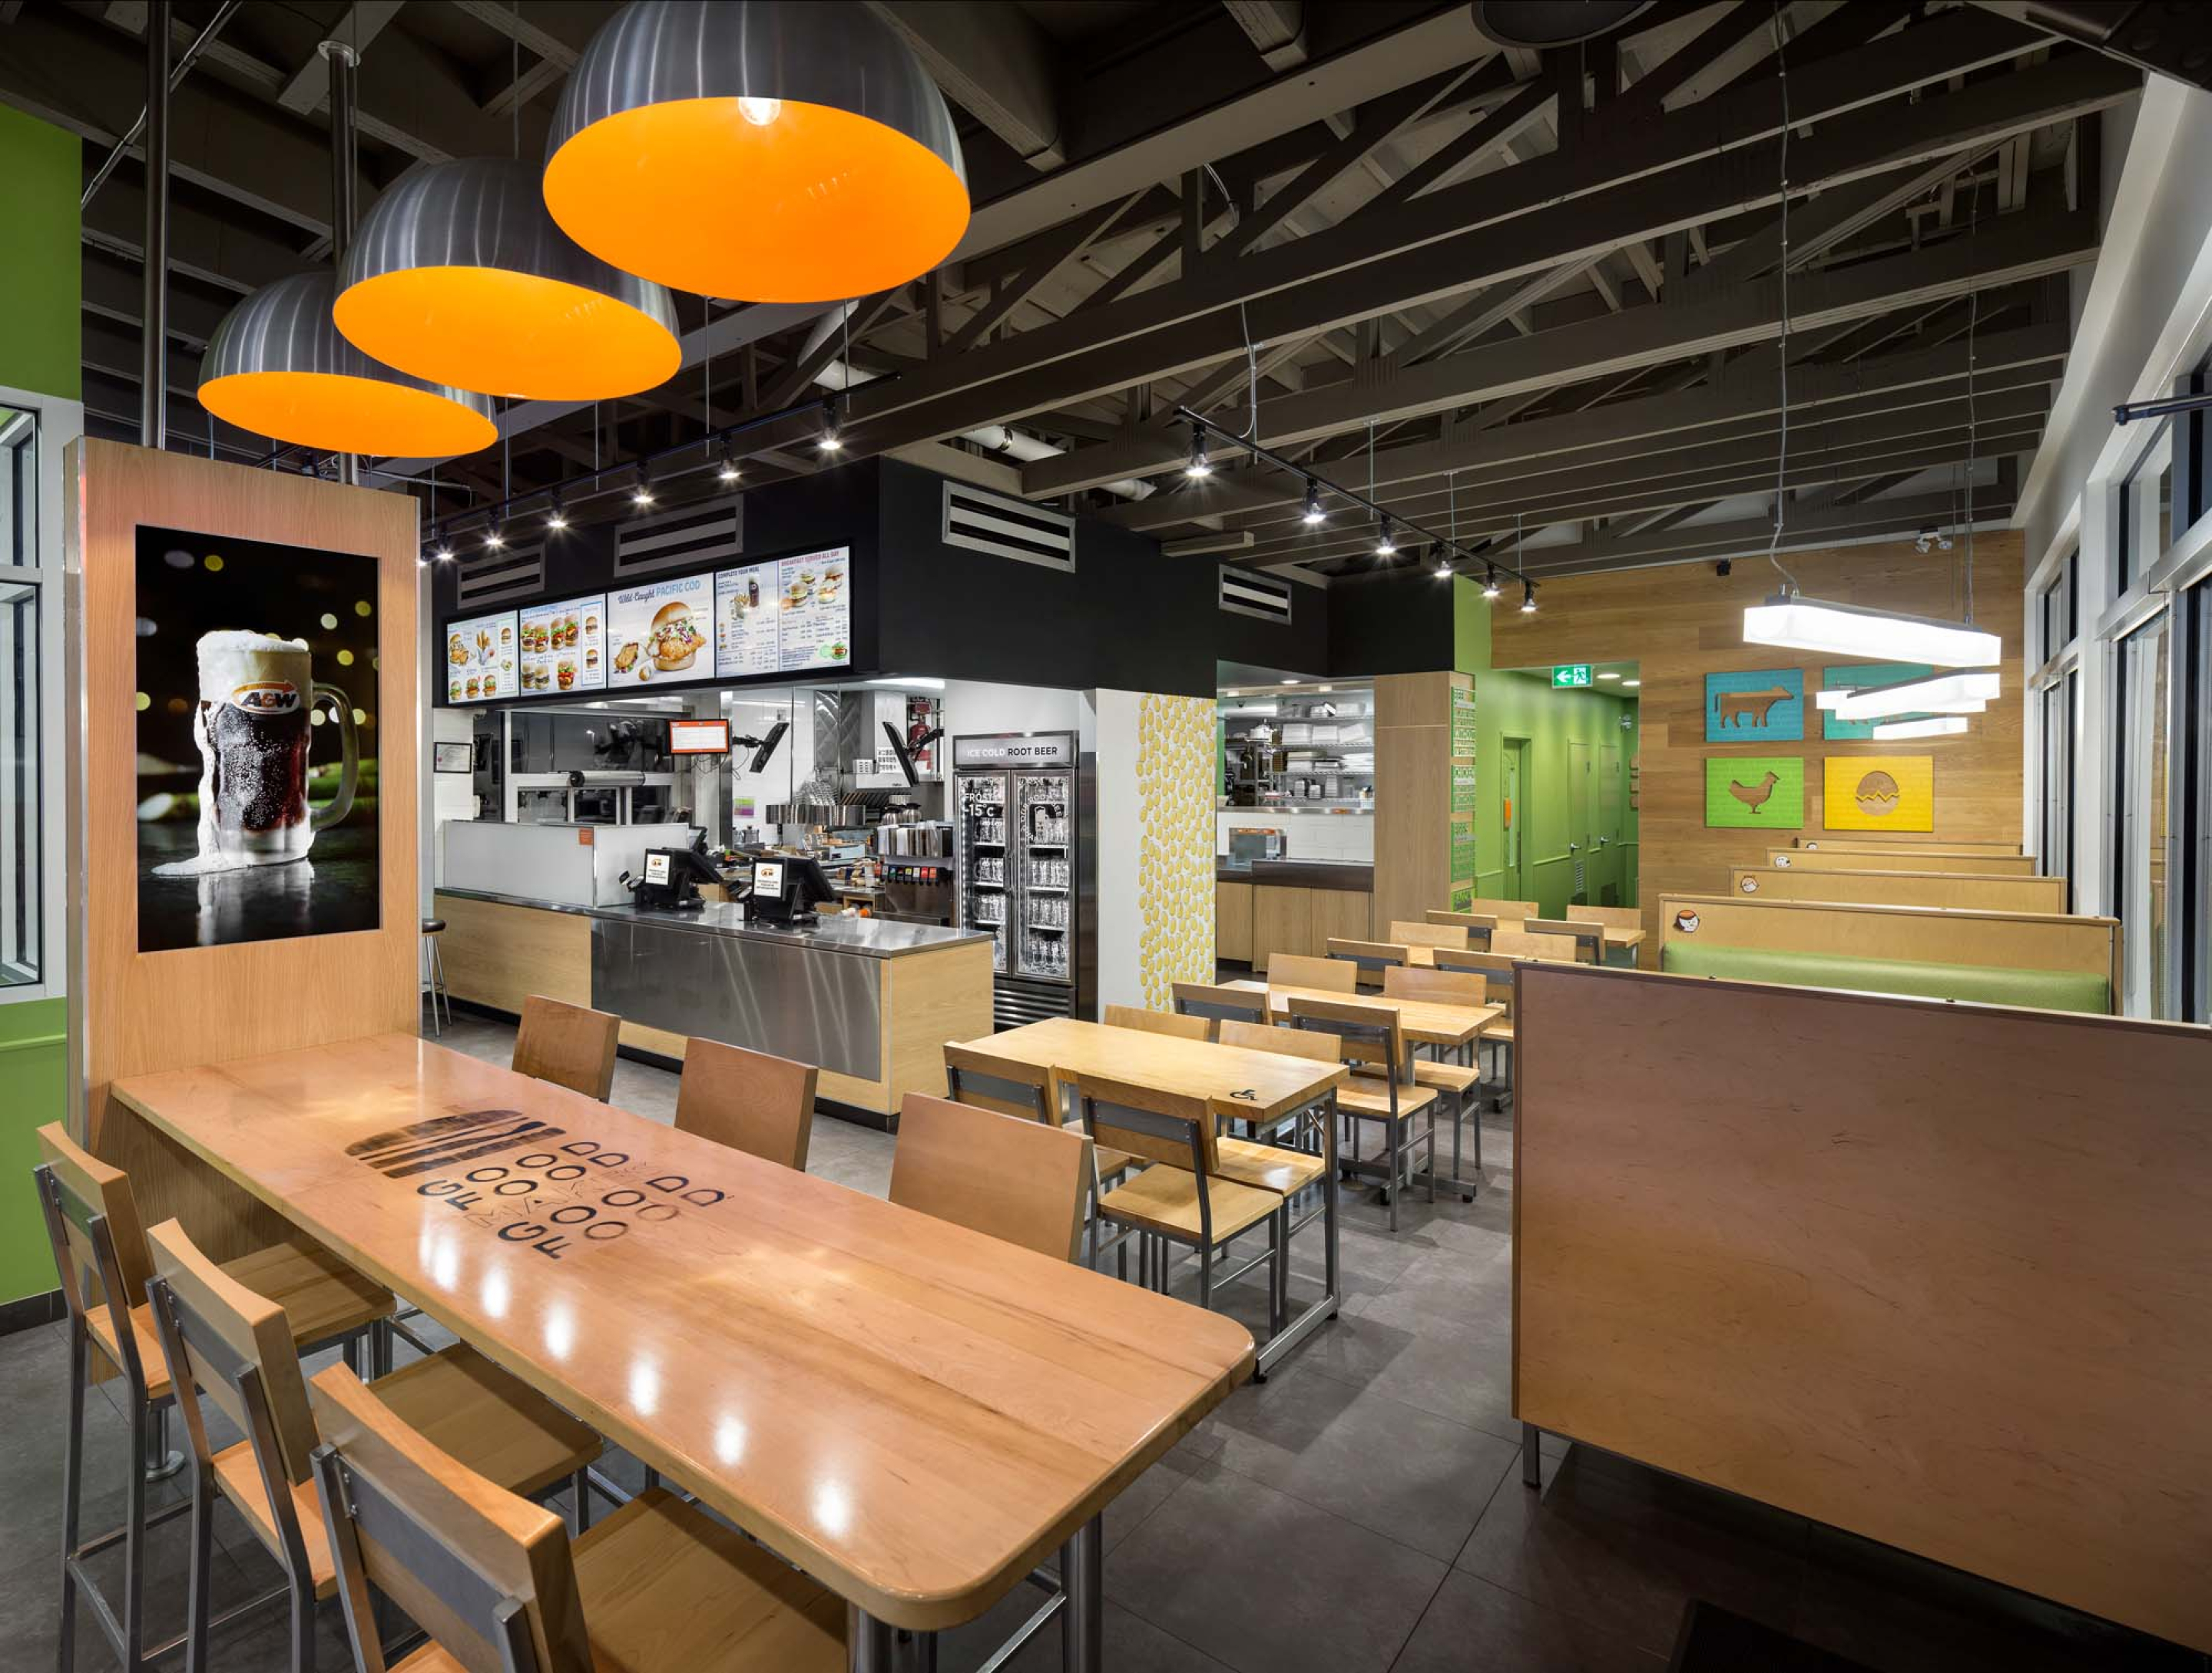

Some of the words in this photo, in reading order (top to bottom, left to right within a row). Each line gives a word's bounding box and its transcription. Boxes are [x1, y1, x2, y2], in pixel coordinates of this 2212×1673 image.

[656, 582, 684, 597] PACIFIC
[684, 579, 700, 592] COD
[240, 691, 297, 708] A&W
[967, 749, 982, 757] ICE
[982, 747, 1005, 757] COLD
[1008, 747, 1034, 757] ROOT
[1035, 746, 1058, 756] BEER
[417, 1141, 601, 1196] GOOD
[445, 1153, 629, 1211] FOOD
[498, 1176, 689, 1242] GOOD
